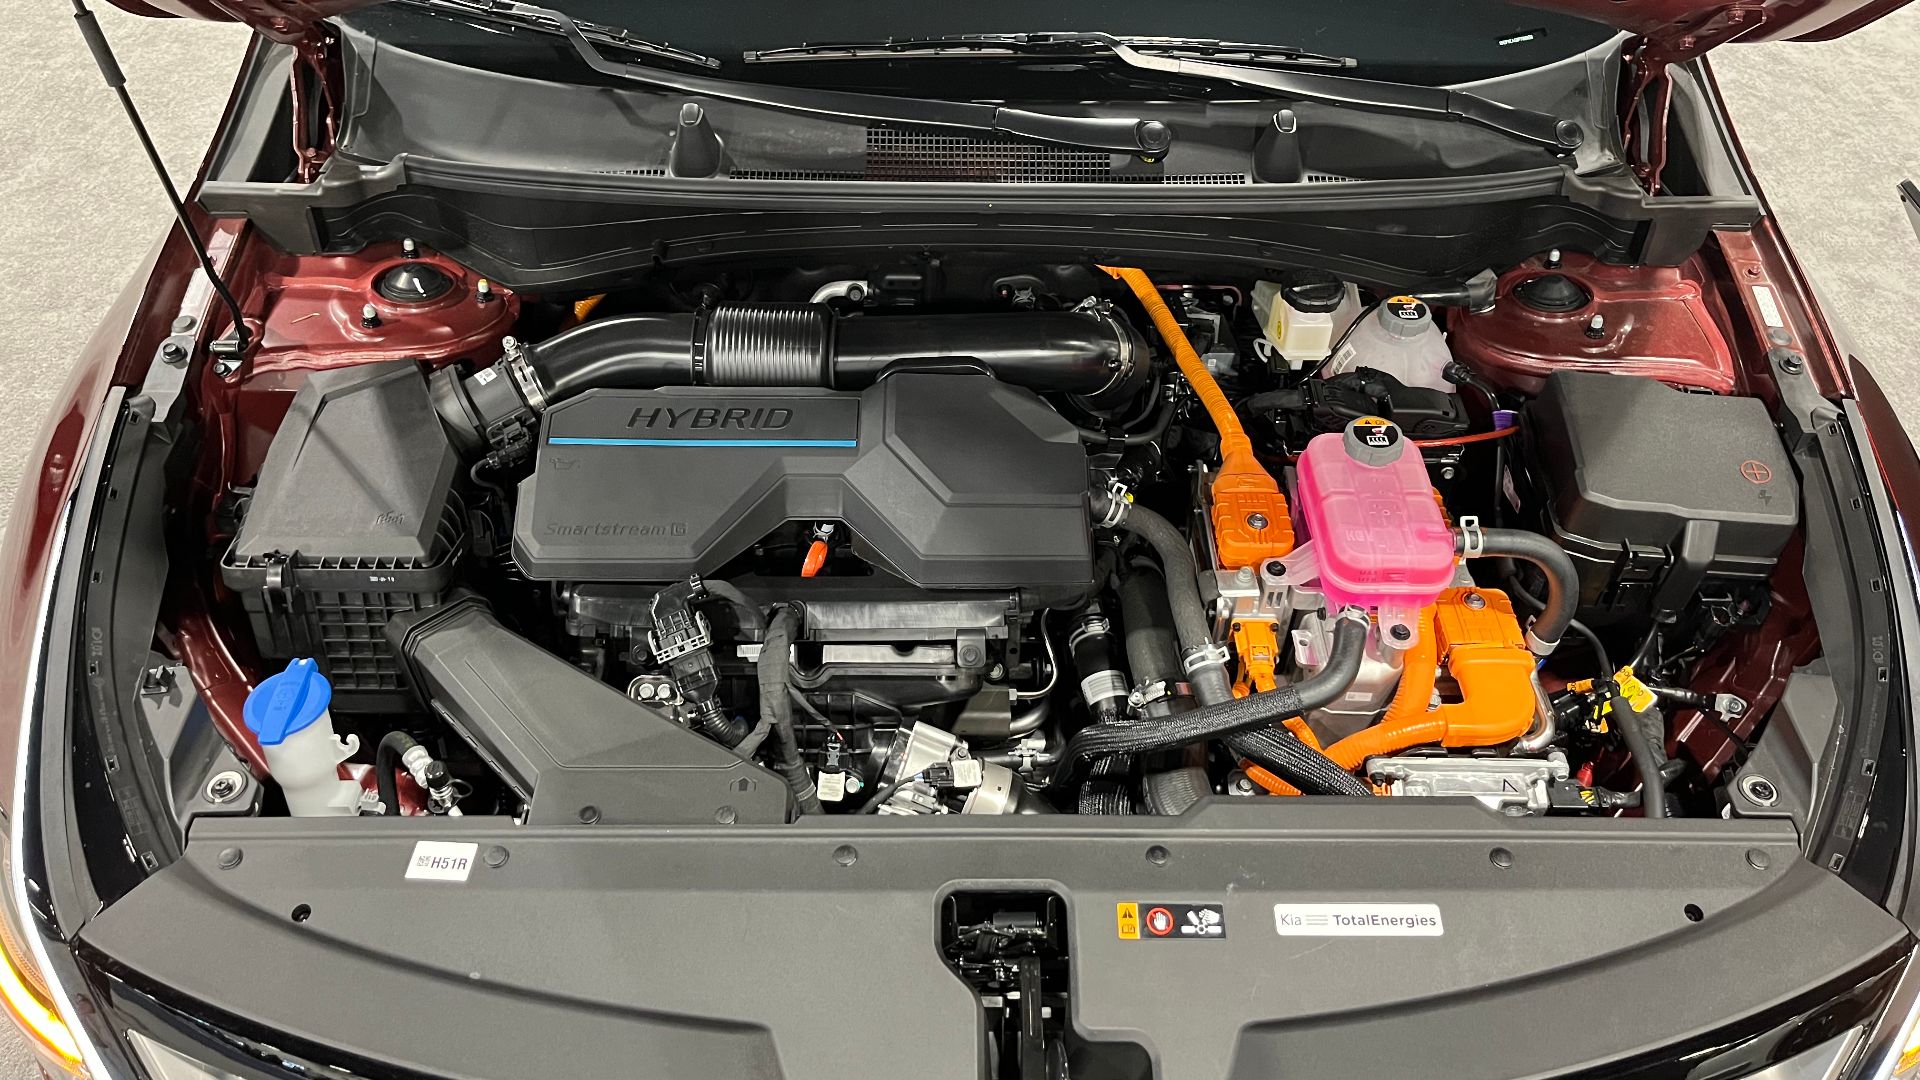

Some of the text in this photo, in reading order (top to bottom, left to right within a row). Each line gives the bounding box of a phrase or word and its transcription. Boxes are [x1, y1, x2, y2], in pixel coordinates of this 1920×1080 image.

[626, 407, 794, 430] HYBRID
[543, 522, 667, 537] Smartstream
[431, 856, 468, 870] H51R
[1280, 913, 1437, 928] Kia TotalEnergies
